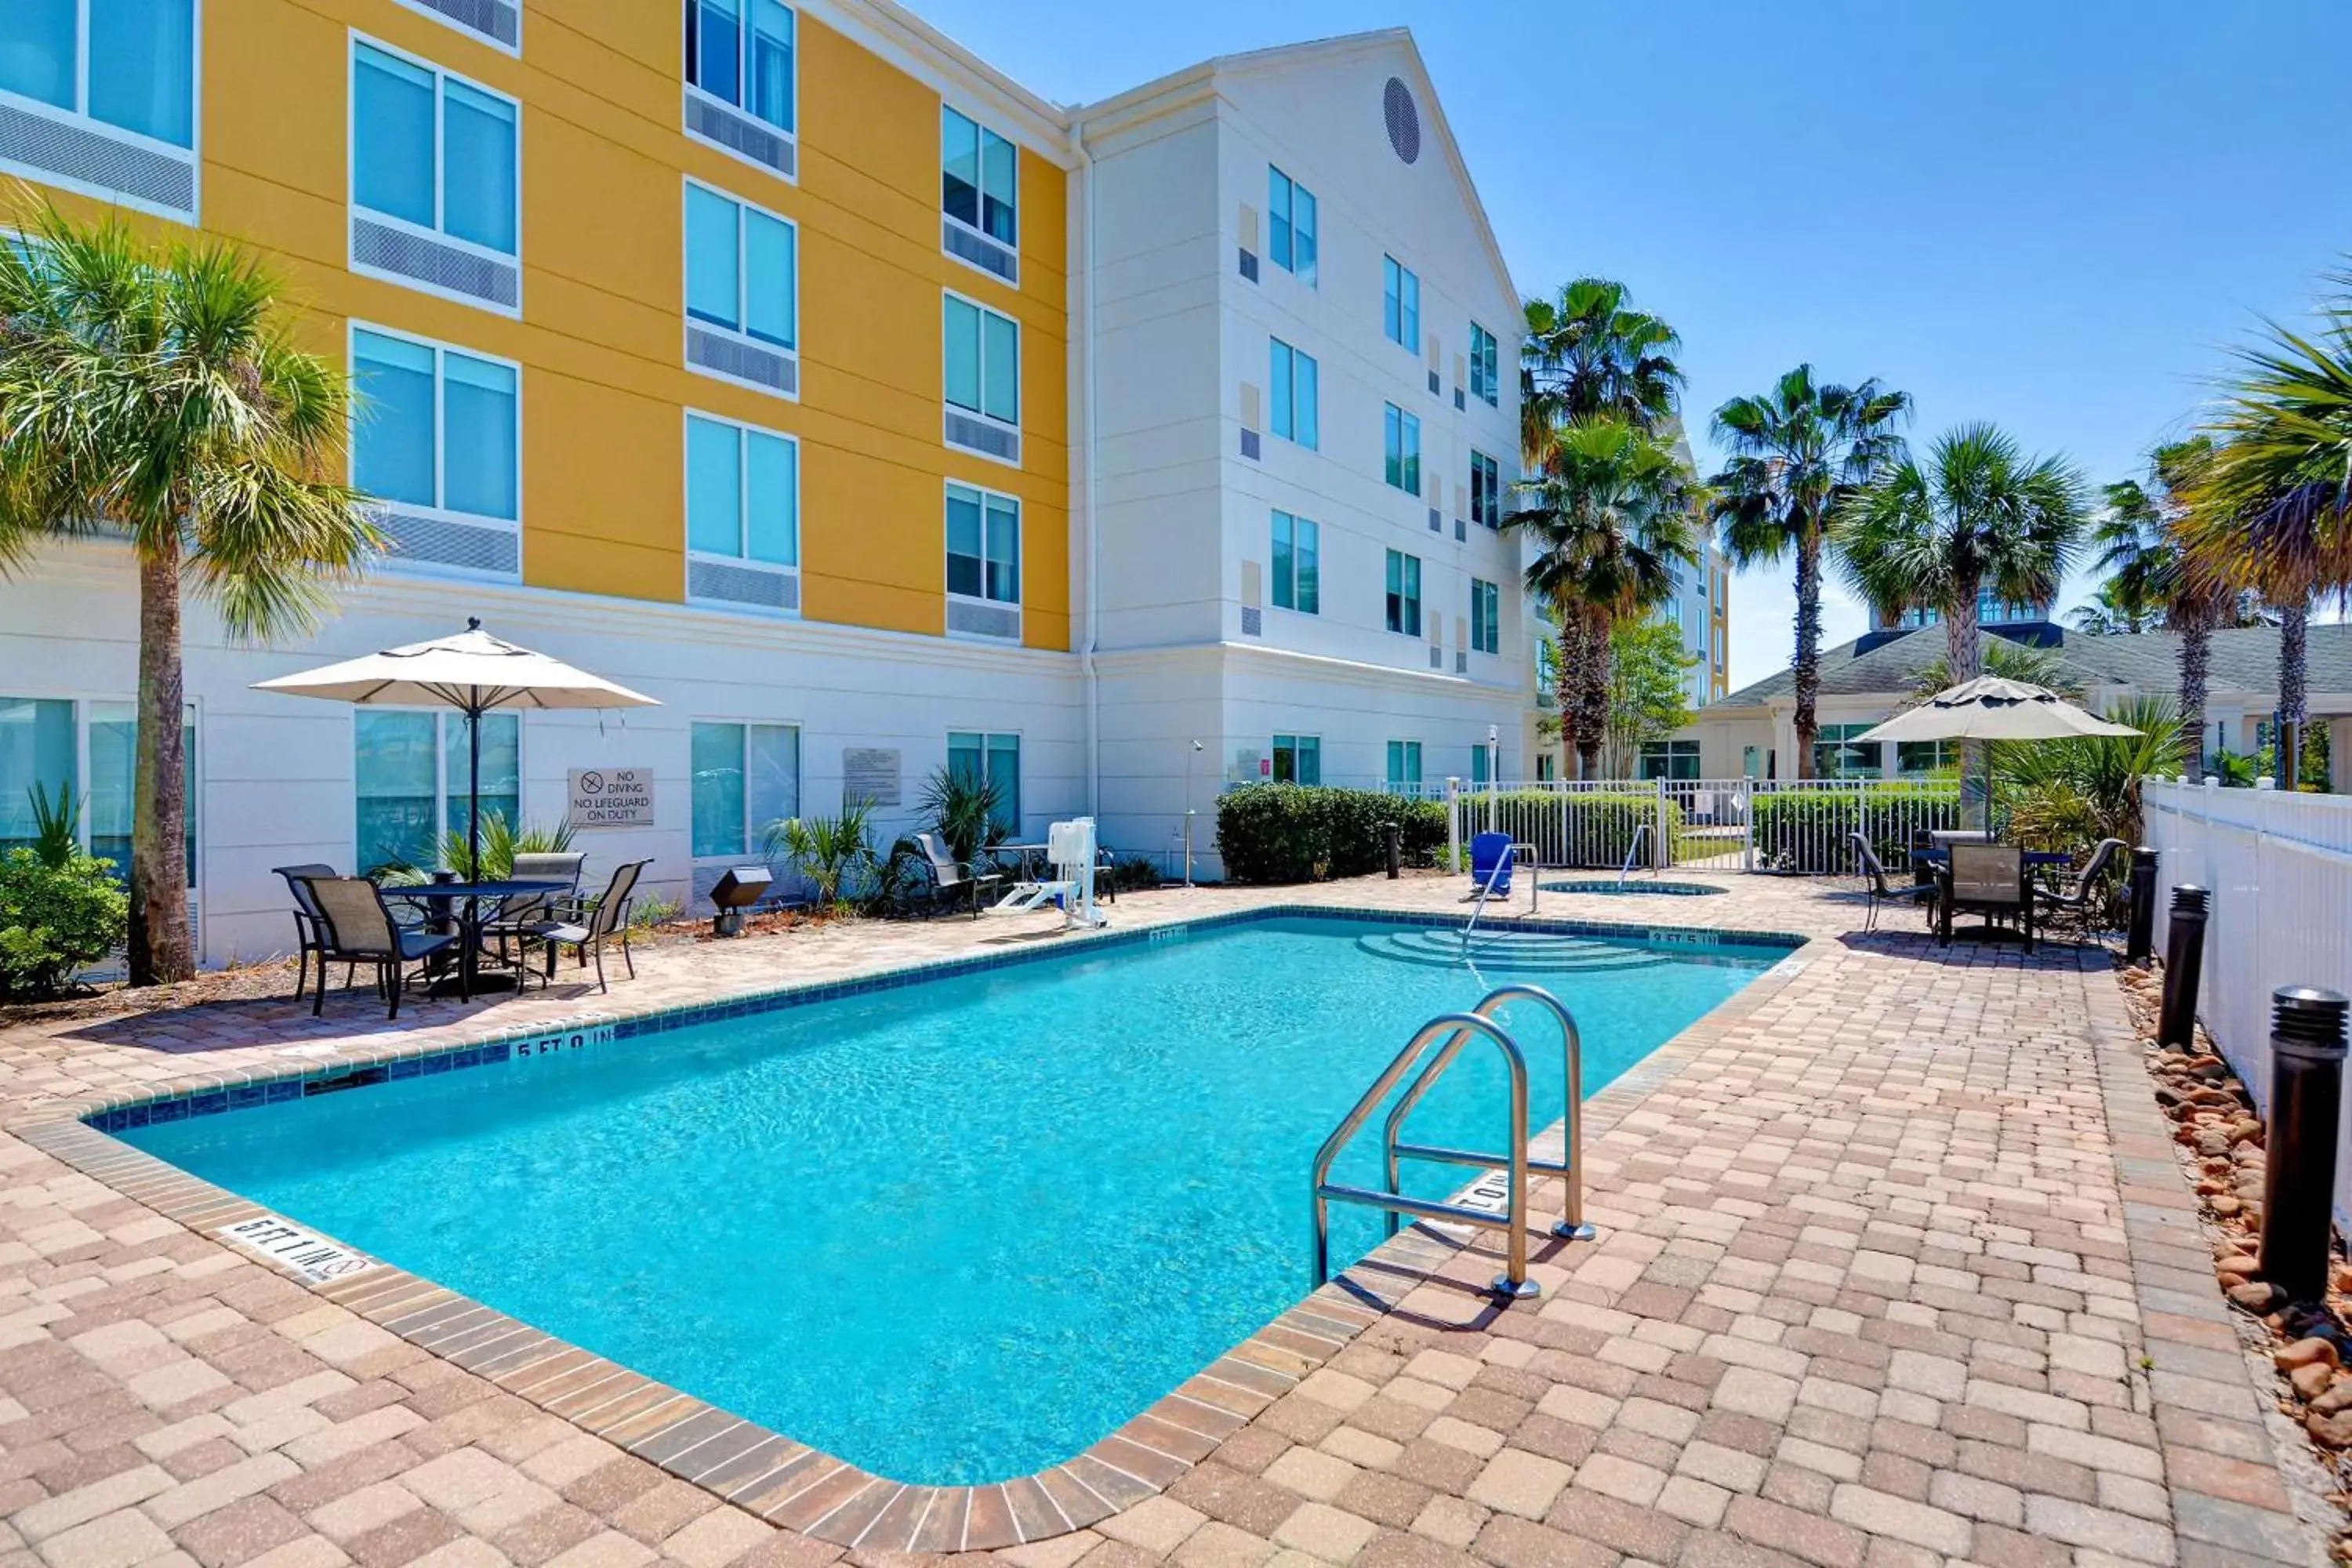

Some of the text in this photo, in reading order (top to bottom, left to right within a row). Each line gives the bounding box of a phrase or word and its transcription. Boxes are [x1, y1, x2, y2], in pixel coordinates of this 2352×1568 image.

[617, 771, 634, 782] NO
[608, 783, 644, 793] DIVING
[574, 797, 649, 808] NO LIFEGUARD
[587, 809, 637, 820] ON DUTY
[517, 1044, 531, 1057] 5
[539, 1038, 561, 1054] FT
[593, 1029, 611, 1044] IN
[234, 1219, 343, 1266] 5 FT 1 IN
